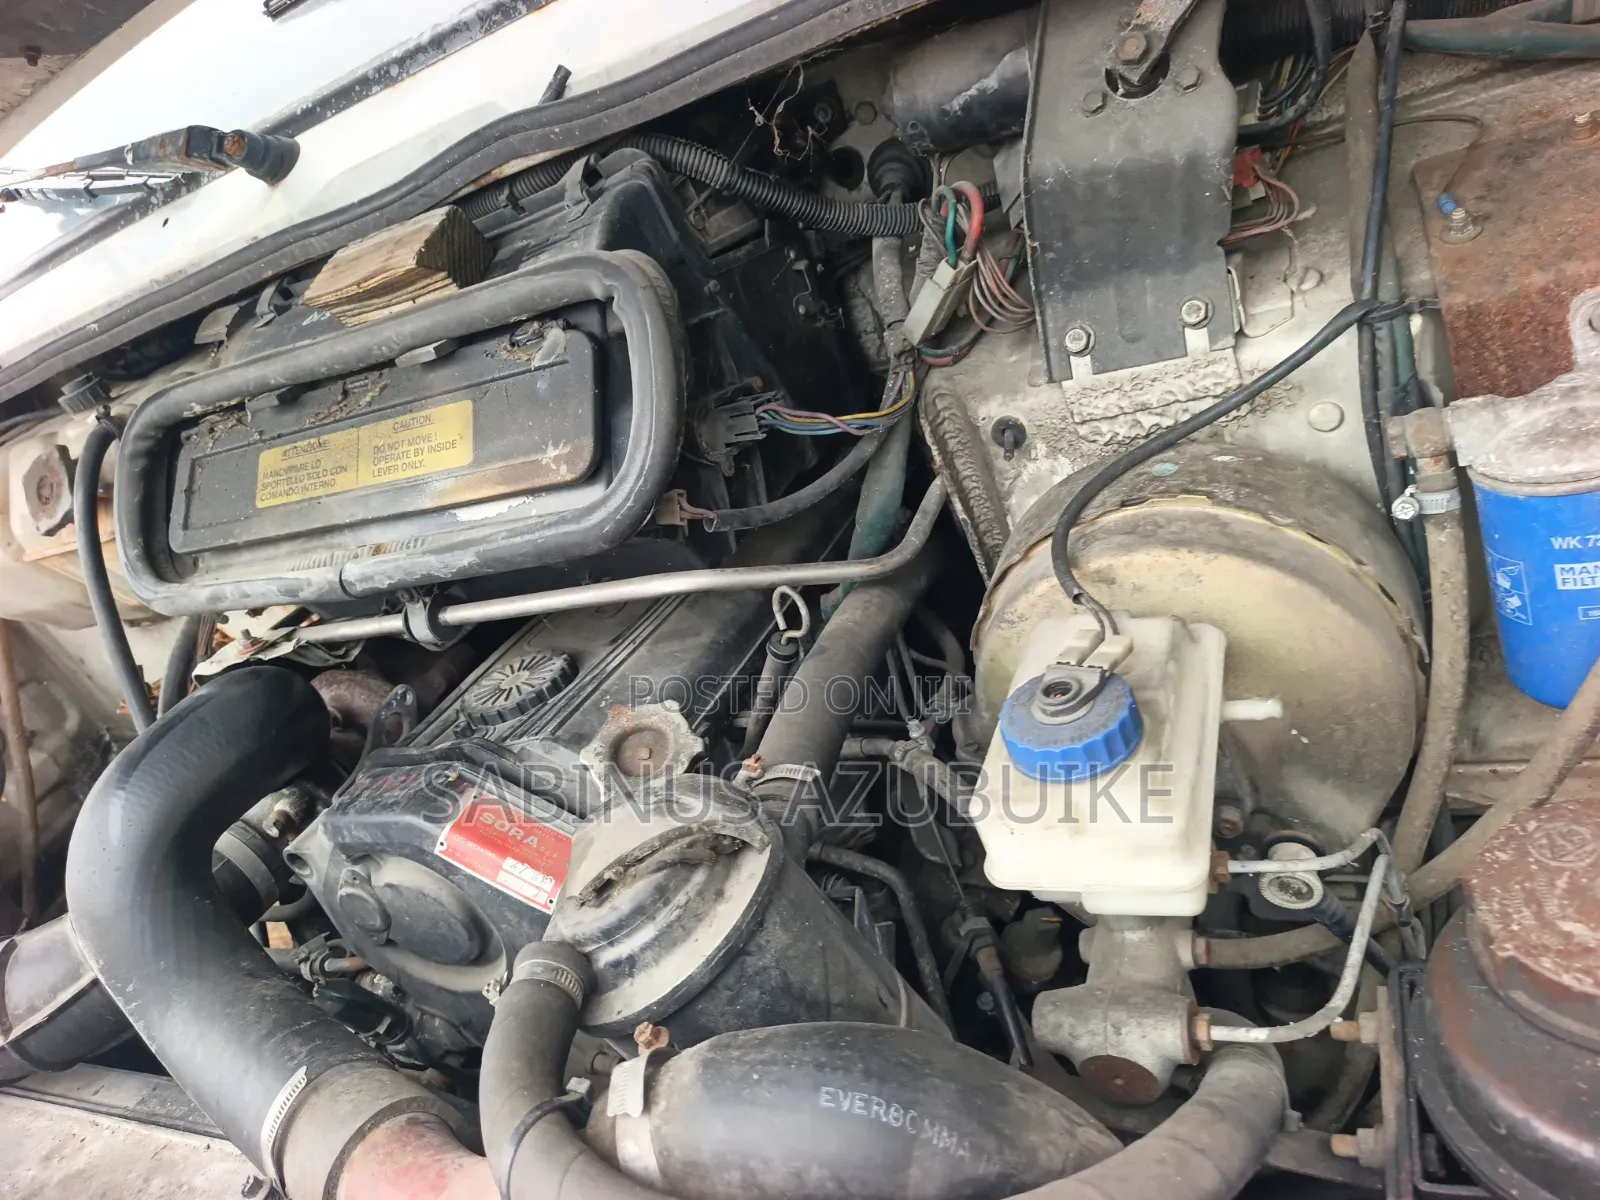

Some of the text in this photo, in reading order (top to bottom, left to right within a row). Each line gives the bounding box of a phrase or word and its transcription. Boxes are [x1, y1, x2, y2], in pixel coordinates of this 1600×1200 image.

[373, 439, 457, 467] OPERATE BY INSIDE
[387, 439, 405, 452] NOT
[261, 464, 347, 491] SPORTELLO SOLO CON
[372, 458, 426, 478] LEVER ONLY.
[260, 486, 299, 501] COMANDO
[1550, 536, 1583, 550] WK
[480, 812, 538, 848] SORA
